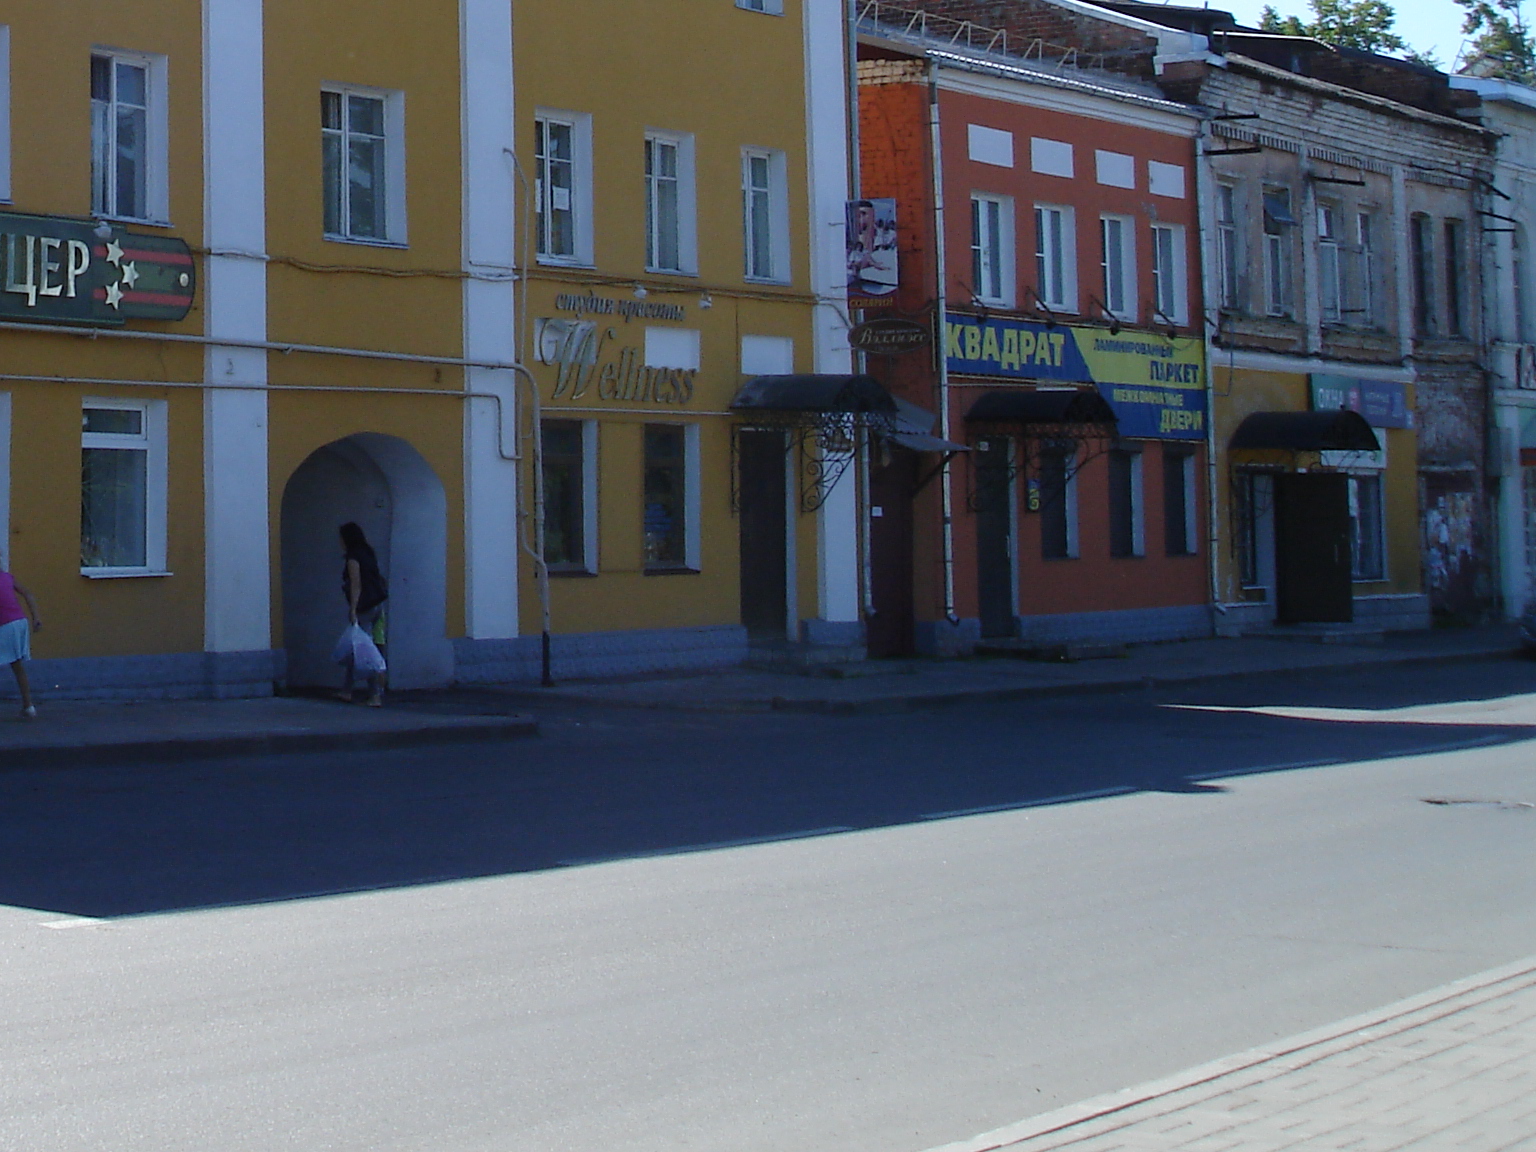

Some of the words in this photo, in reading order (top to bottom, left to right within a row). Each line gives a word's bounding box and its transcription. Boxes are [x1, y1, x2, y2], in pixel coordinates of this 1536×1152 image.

[539, 318, 696, 404] Wellness
[947, 322, 1066, 371] КВАДРАТ
[1150, 360, 1199, 383] ПАРКЕТ
[1160, 409, 1203, 433] ДВЕРИ
